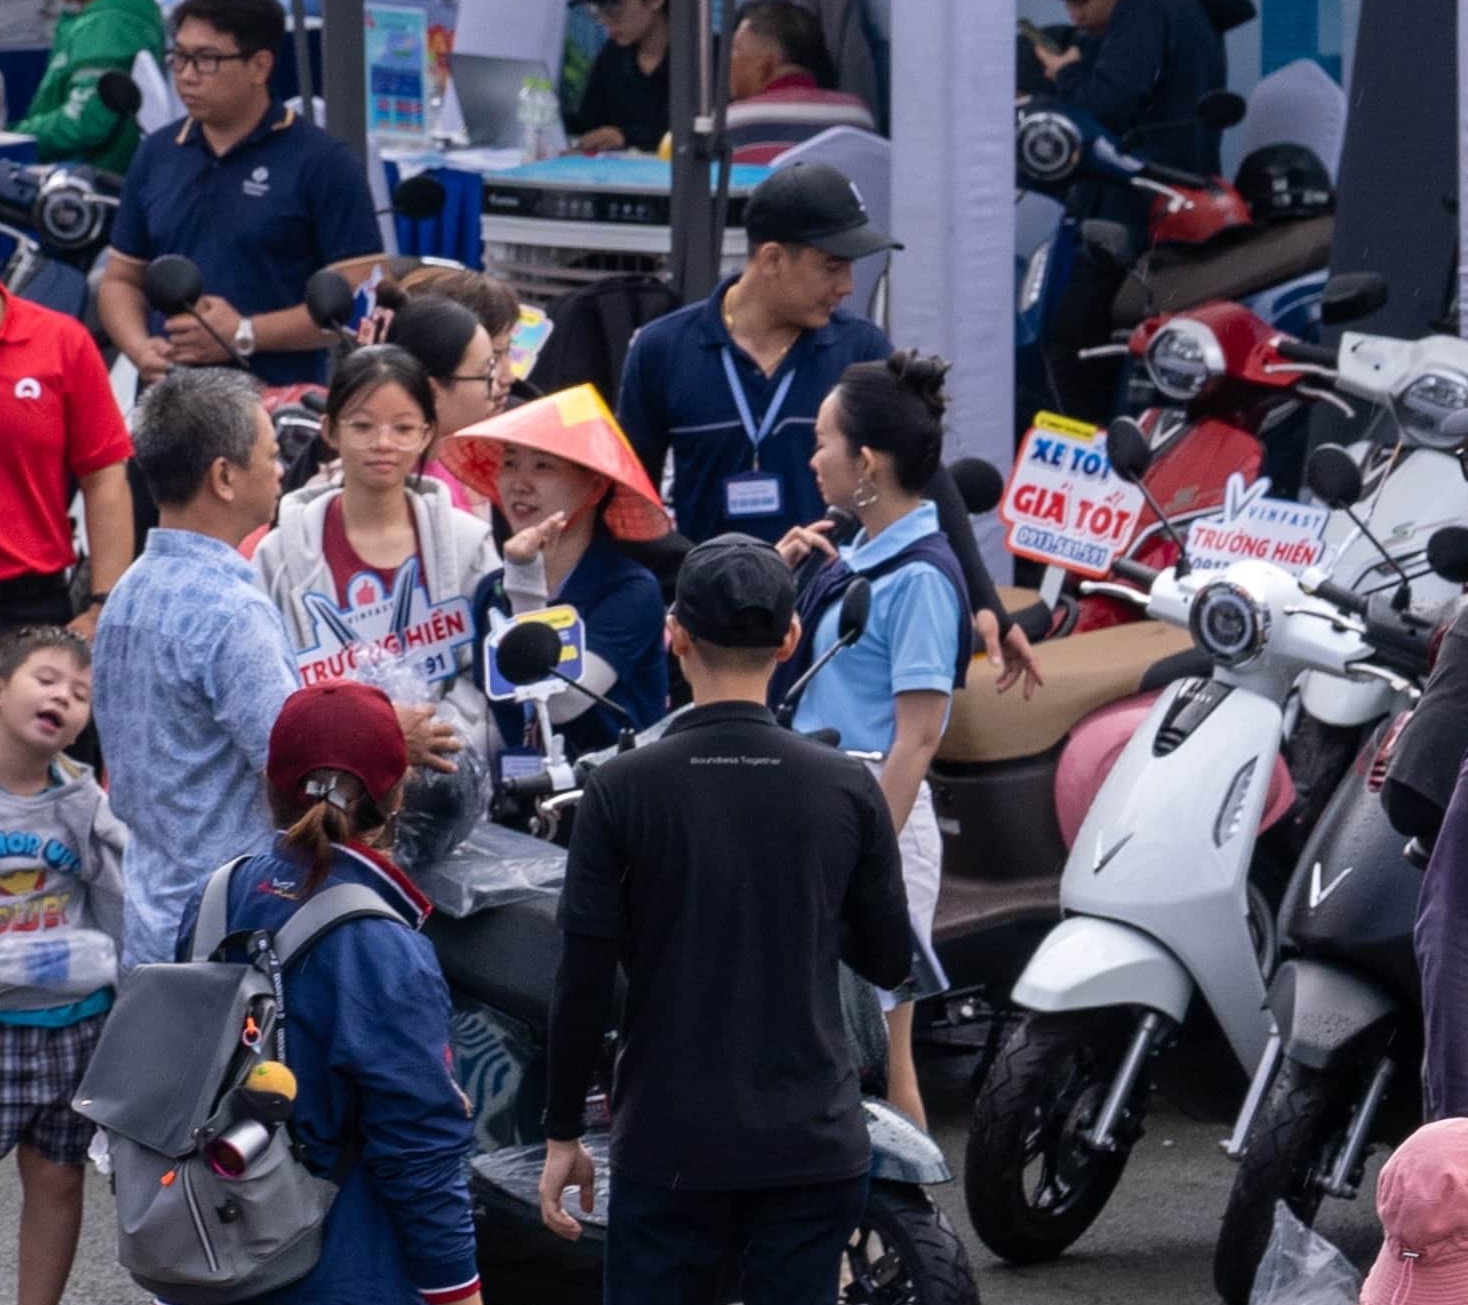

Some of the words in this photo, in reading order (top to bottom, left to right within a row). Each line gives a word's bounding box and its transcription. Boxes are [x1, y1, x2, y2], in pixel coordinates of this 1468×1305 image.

[1031, 437, 1066, 467] XE
[1076, 490, 1131, 540] TỐT
[1249, 505, 1321, 530] VINFAST
